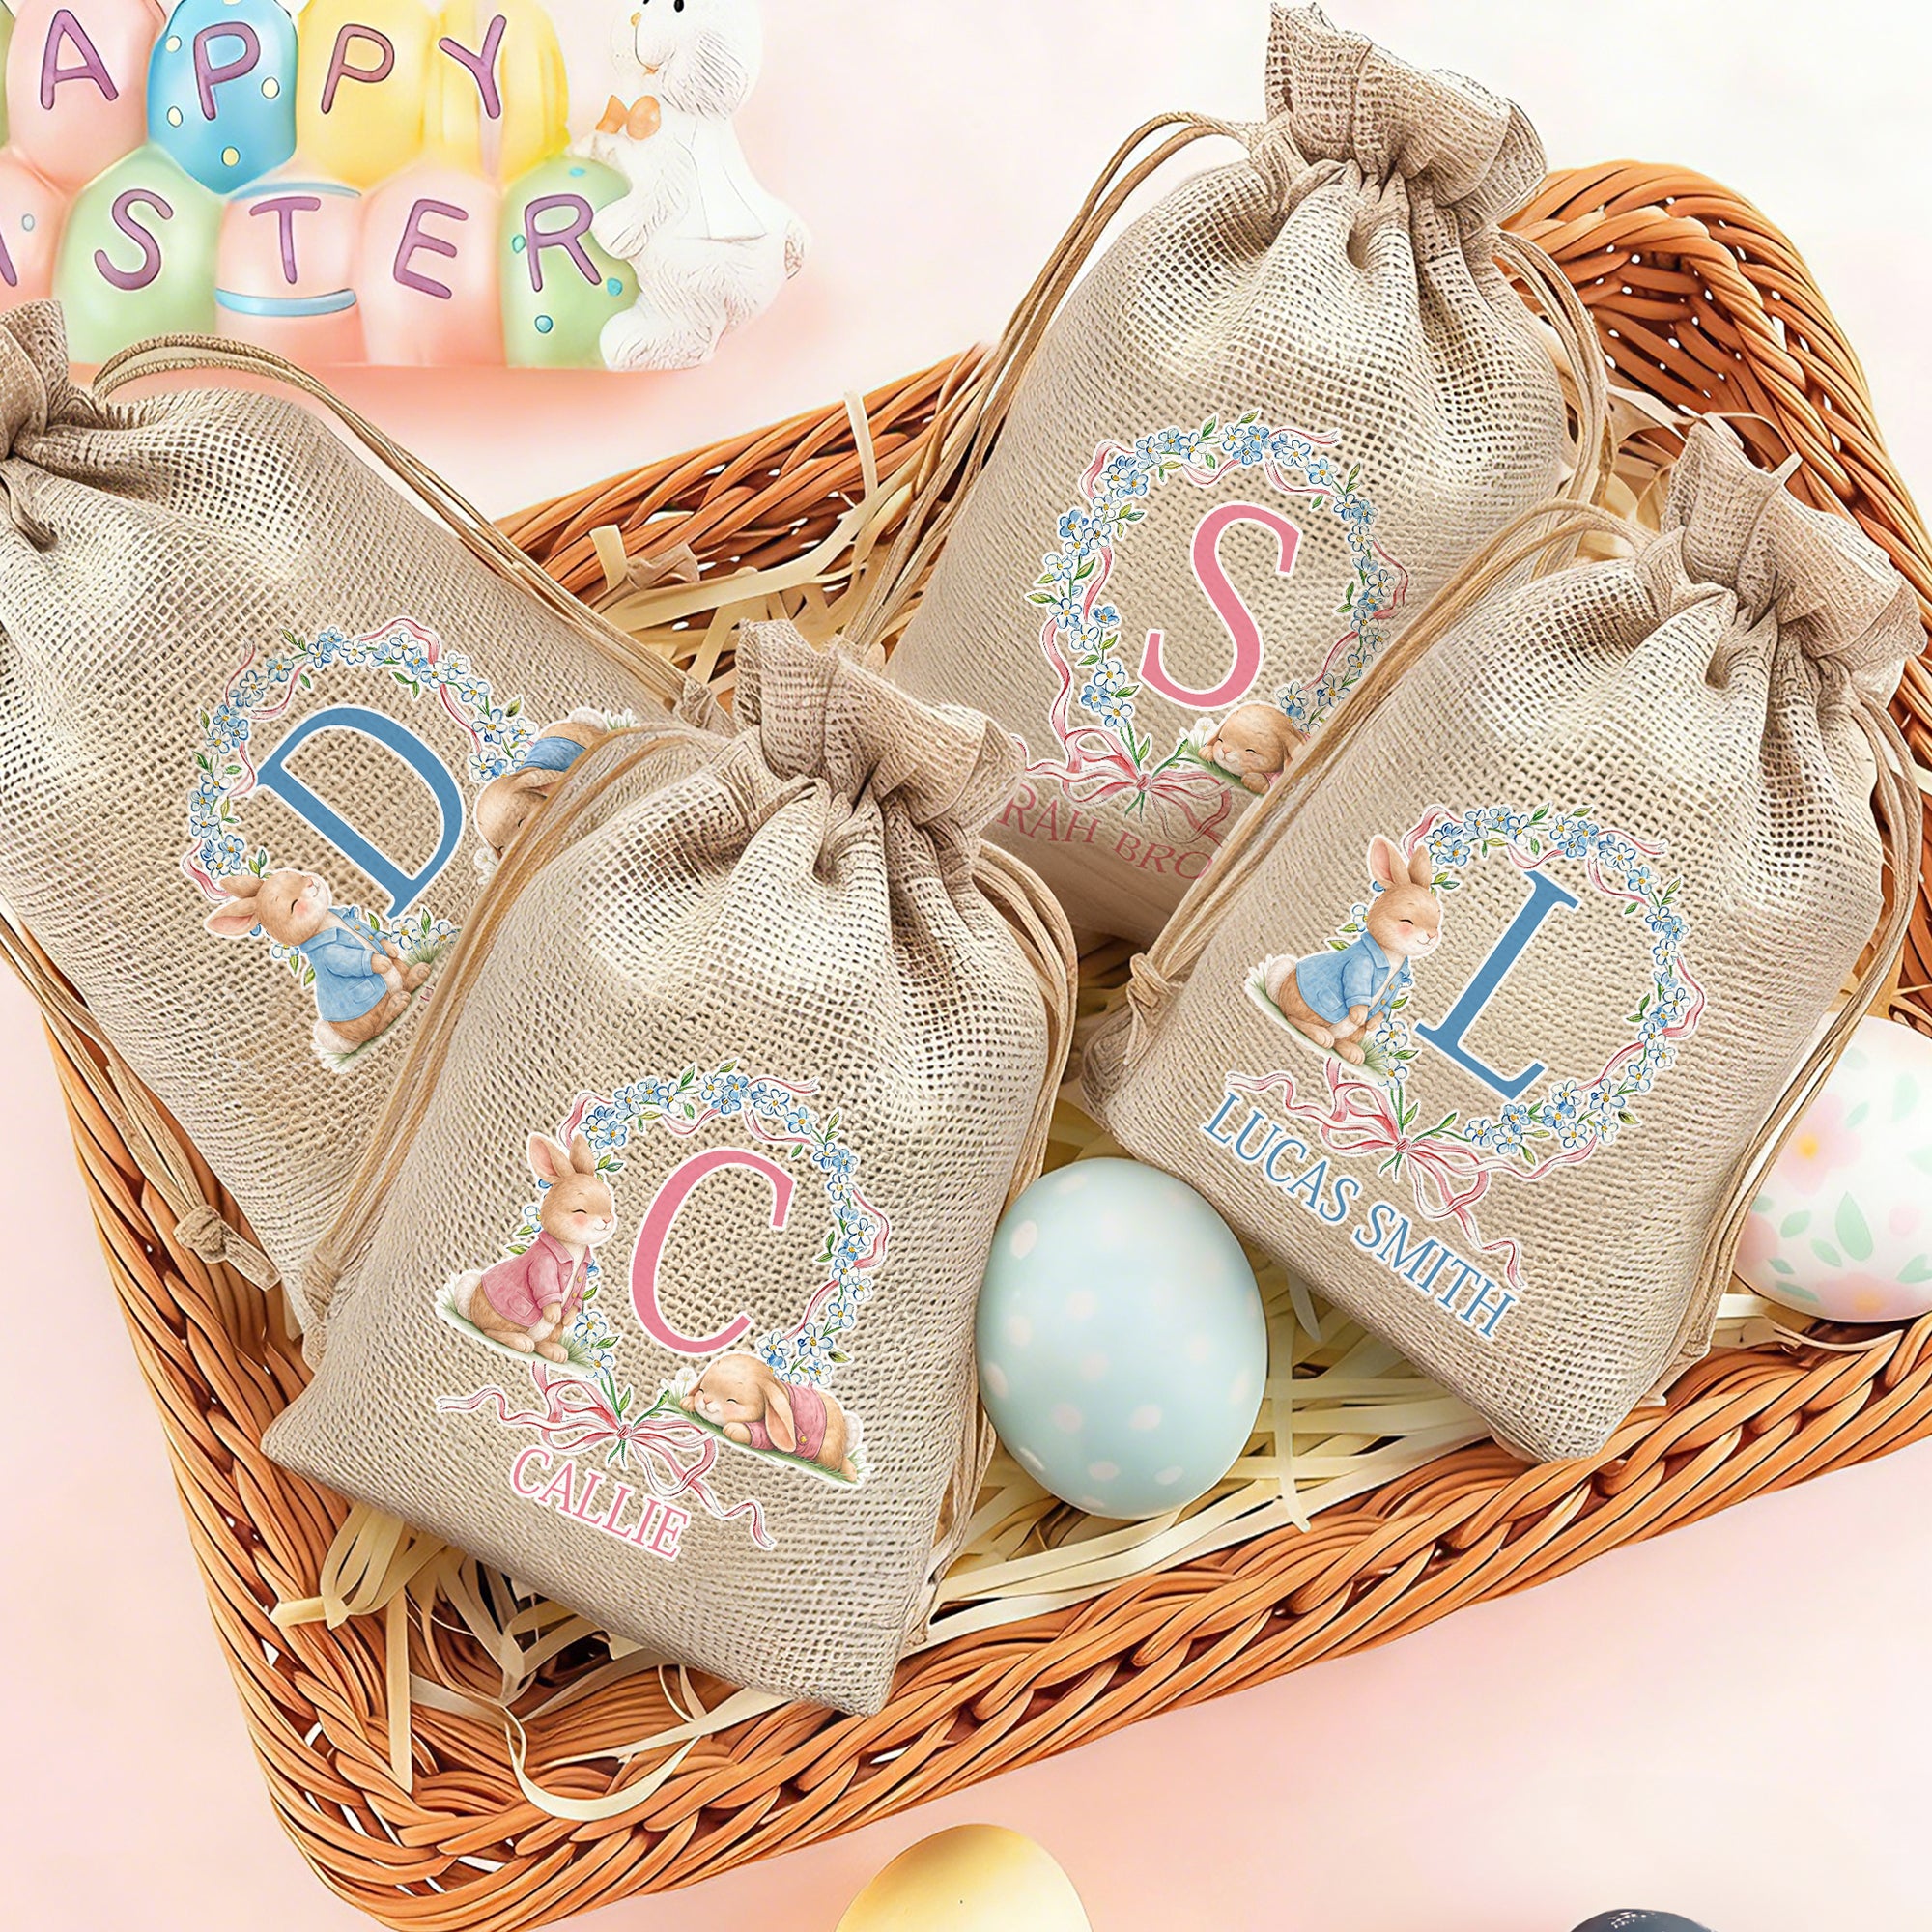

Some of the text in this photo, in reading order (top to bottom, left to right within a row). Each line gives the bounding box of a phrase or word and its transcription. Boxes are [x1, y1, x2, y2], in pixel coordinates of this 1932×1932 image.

[0, 189, 603, 299] STER
[1140, 504, 1299, 708] S
[257, 706, 464, 919] D
[1414, 870, 1578, 1100] L
[631, 1150, 796, 1353] C
[1202, 1092, 1517, 1338] LUCAS SMITH
[512, 1448, 688, 1558] CALLIE
